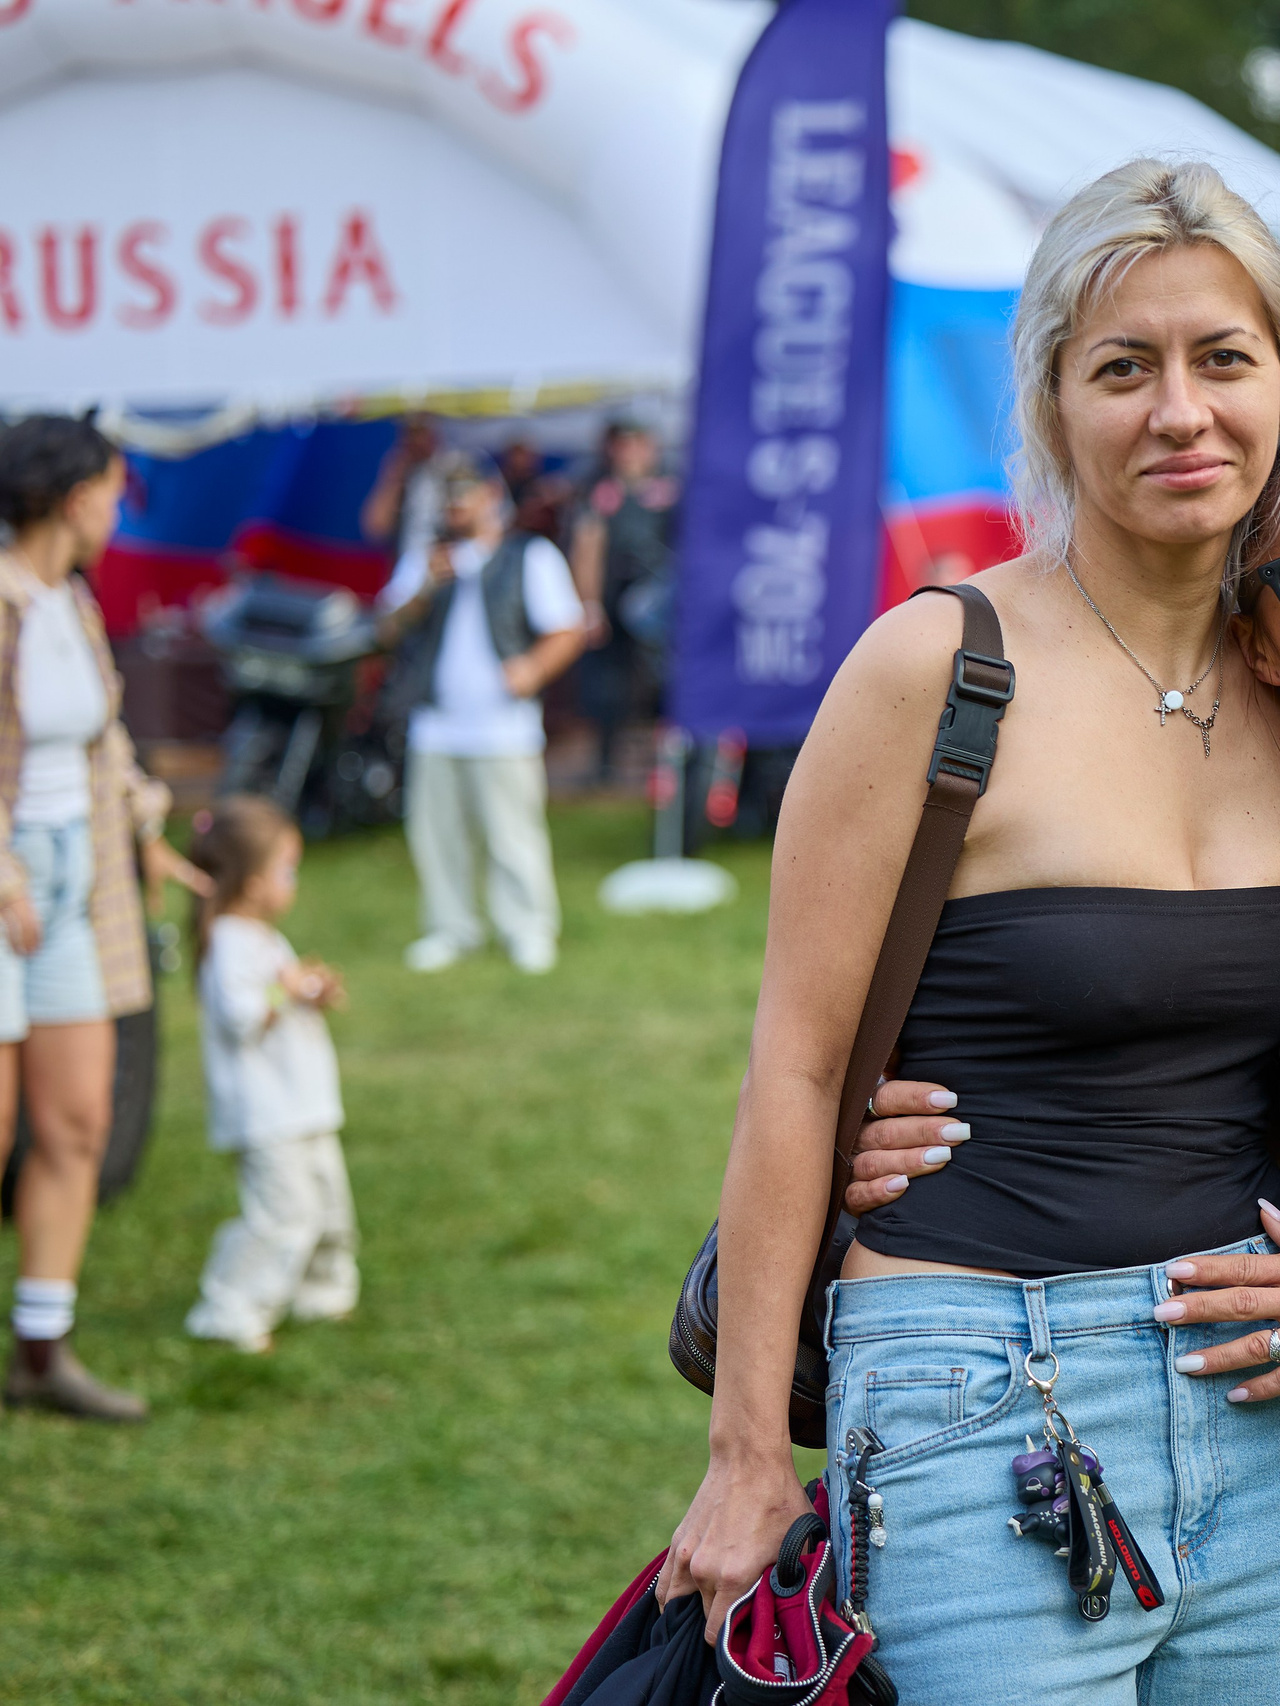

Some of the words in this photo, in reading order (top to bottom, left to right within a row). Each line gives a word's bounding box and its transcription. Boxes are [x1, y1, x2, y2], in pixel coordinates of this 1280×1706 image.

[750, 100, 867, 434] LEAGUE
[1088, 1503, 1108, 1566] DRAGONRUN
[1108, 1519, 1140, 1581] QJMOTOR
